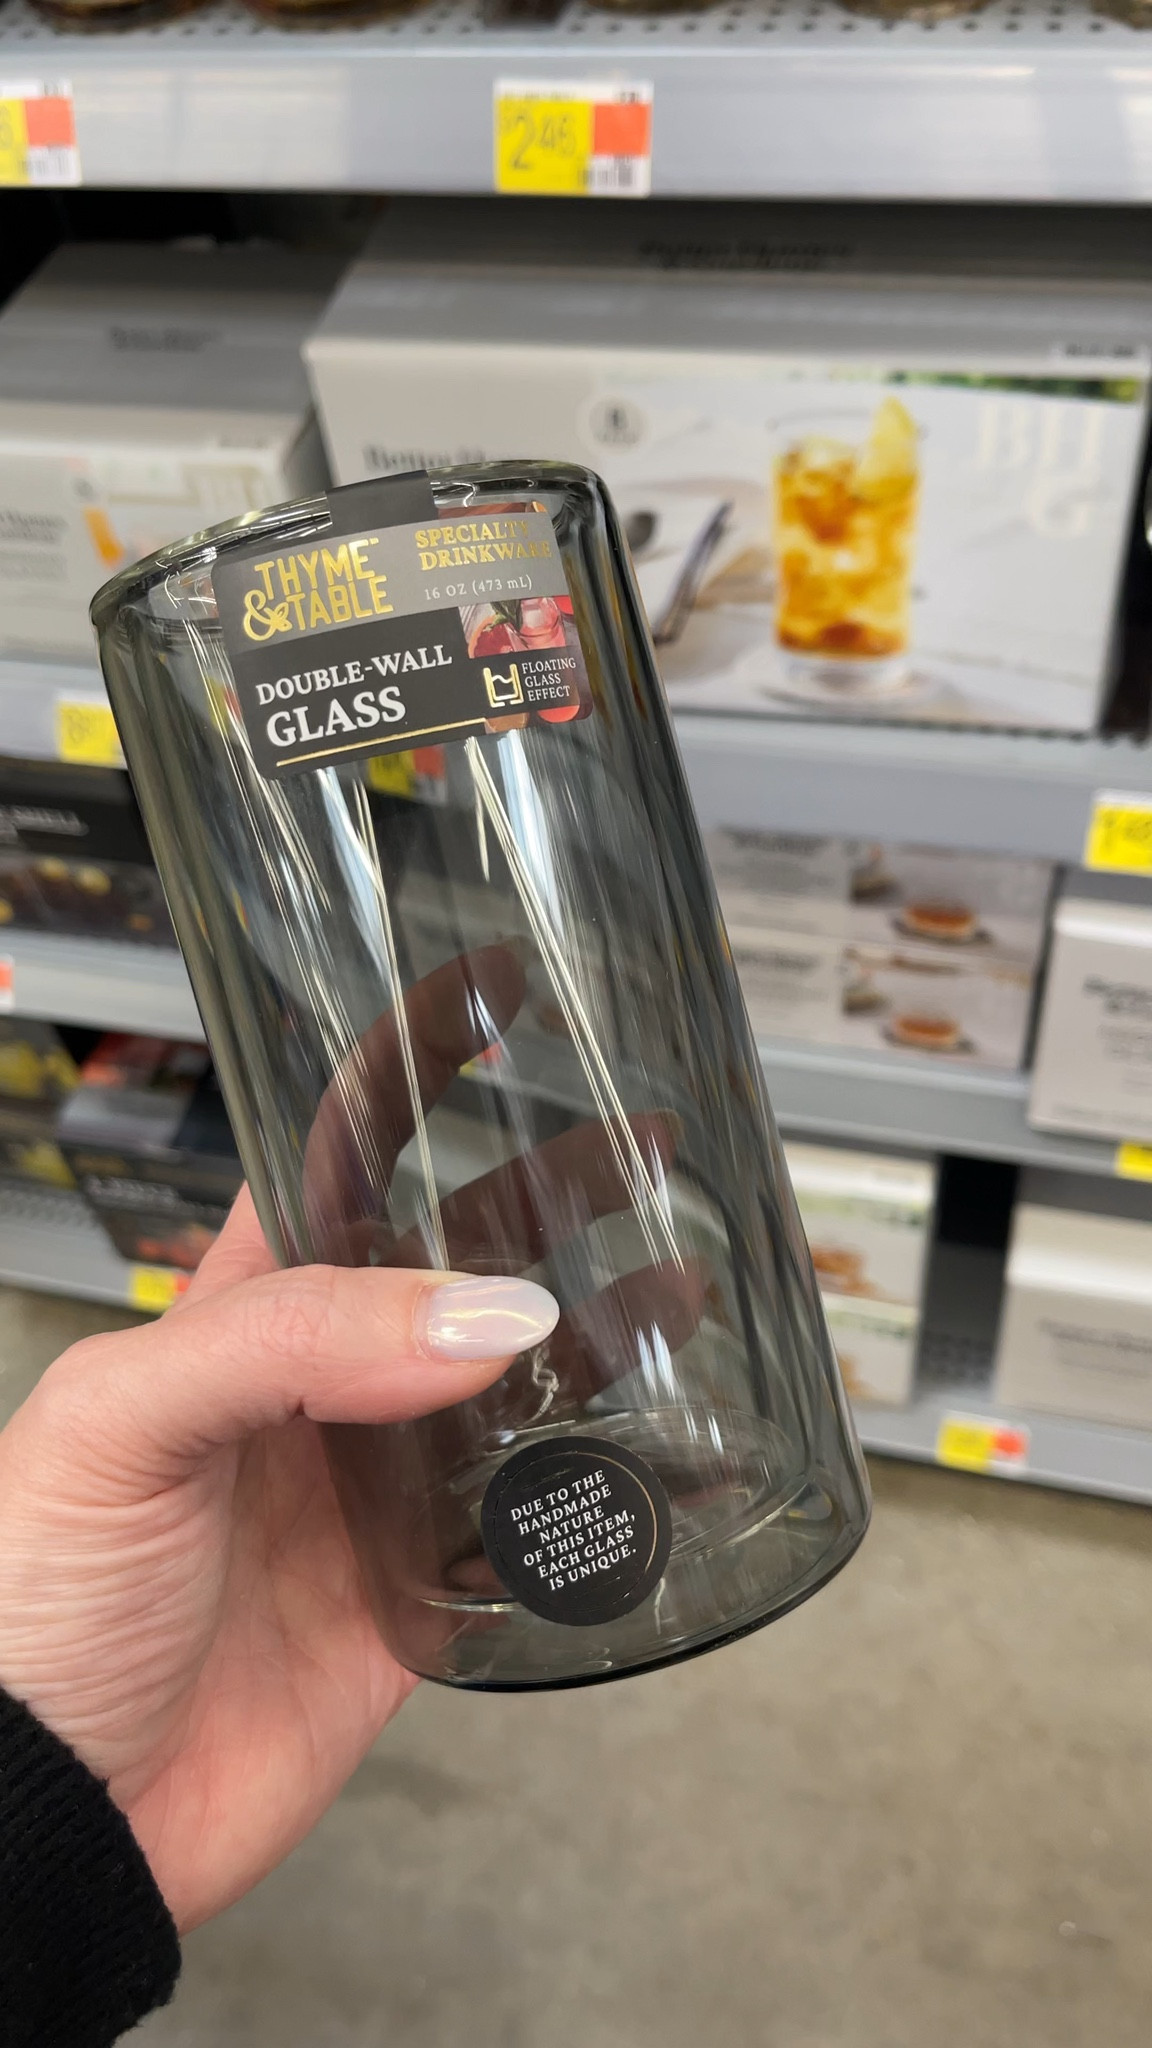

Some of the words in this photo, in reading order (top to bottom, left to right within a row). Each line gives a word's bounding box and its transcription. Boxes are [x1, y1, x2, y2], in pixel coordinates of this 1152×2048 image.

[414, 520, 529, 549] SPECIALTY
[418, 540, 552, 571] DRINKWARE
[424, 587, 441, 600] 16
[446, 583, 467, 597] OZ
[472, 578, 502, 596] (473
[507, 574, 532, 590] mL)
[255, 644, 453, 706] DOUBLE-WALL
[521, 657, 576, 674] FLOATING
[524, 672, 561, 688] GLASS
[527, 685, 570, 702] EFFECT
[266, 686, 406, 747] GLASS
[510, 1498, 544, 1521] DUE
[546, 1487, 569, 1506] TO
[571, 1469, 606, 1494] THE
[518, 1484, 612, 1536] HANDMADE
[523, 1549, 543, 1567] OF
[546, 1532, 585, 1558] THIS
[588, 1509, 635, 1541] ITEM,
[538, 1505, 605, 1544] NATURE
[538, 1553, 580, 1578] EACH
[584, 1525, 634, 1560] GLASS
[549, 1575, 565, 1591] IS
[568, 1543, 637, 1583] UNIQUE.
